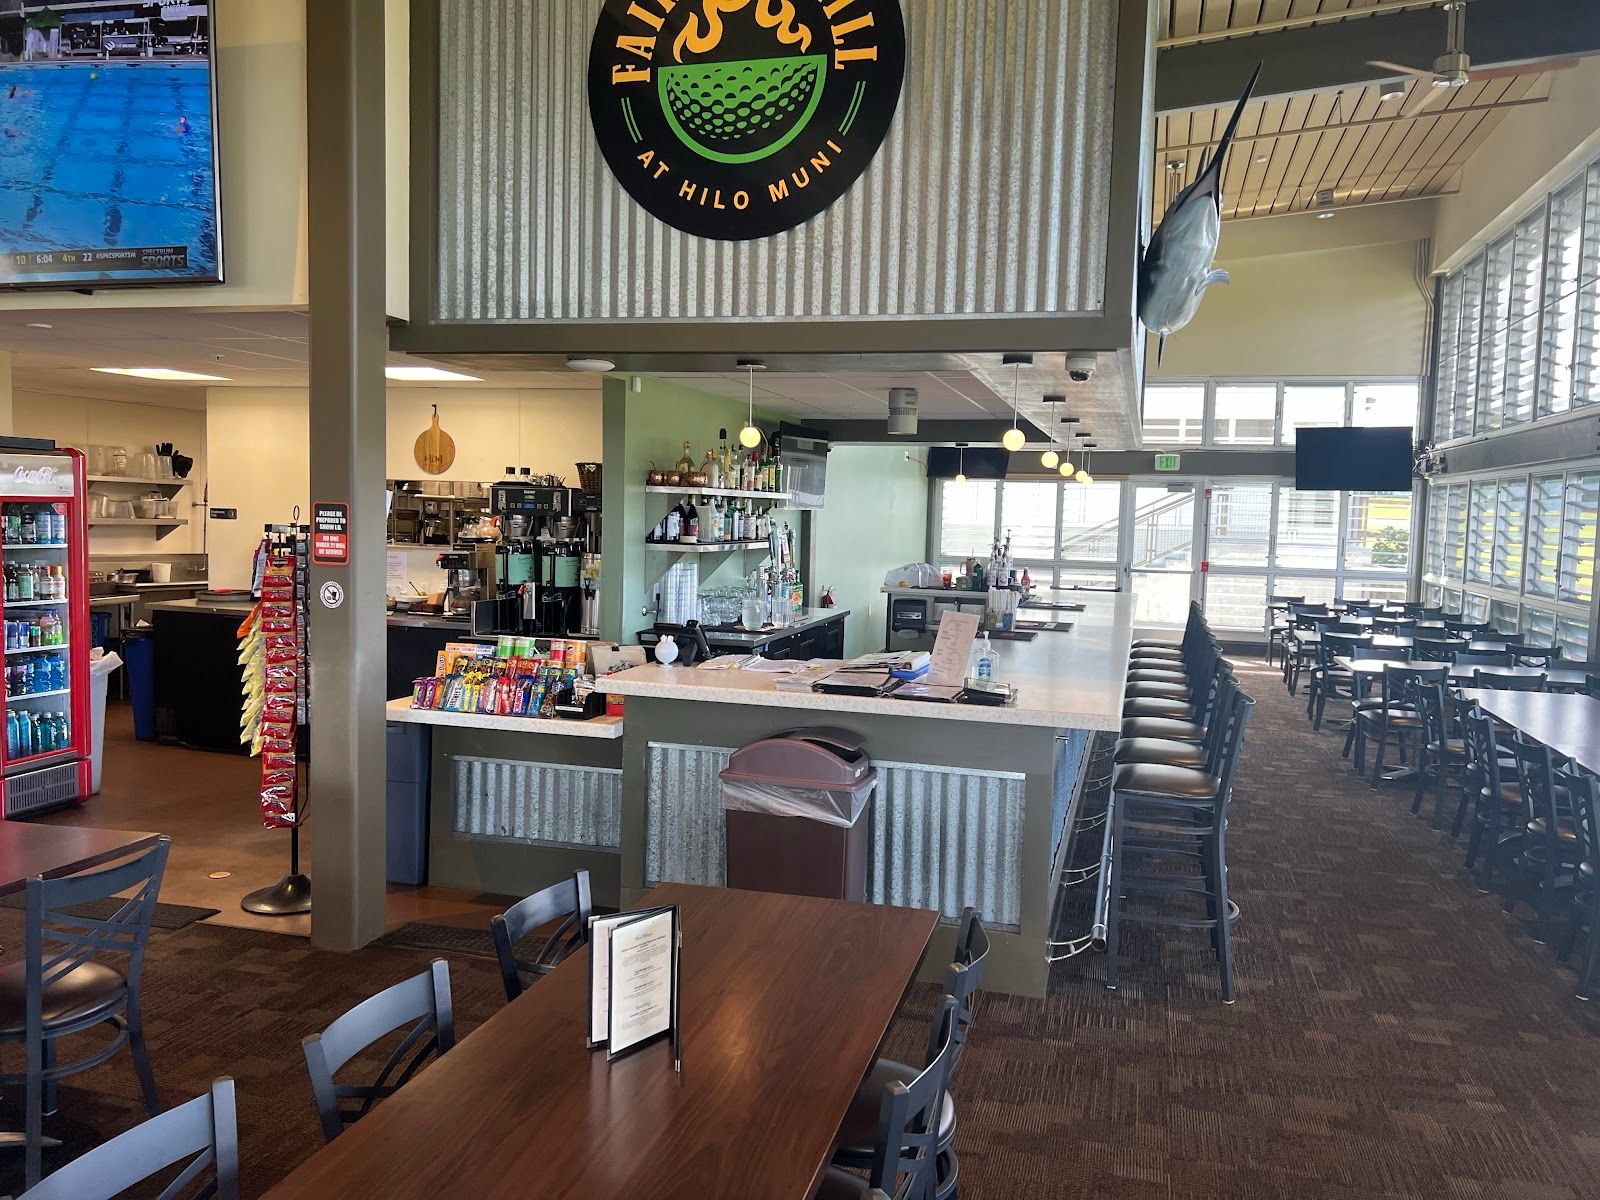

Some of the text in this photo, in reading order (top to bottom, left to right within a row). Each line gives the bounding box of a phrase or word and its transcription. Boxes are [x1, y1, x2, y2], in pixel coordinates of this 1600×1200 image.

[612, 0, 676, 86] FAI
[637, 139, 843, 210] AT HILO MUNI
[36, 254, 53, 264] 6:04
[82, 252, 93, 262] 22
[141, 254, 185, 268] SPORTS
[1159, 455, 1177, 469] EXIT
